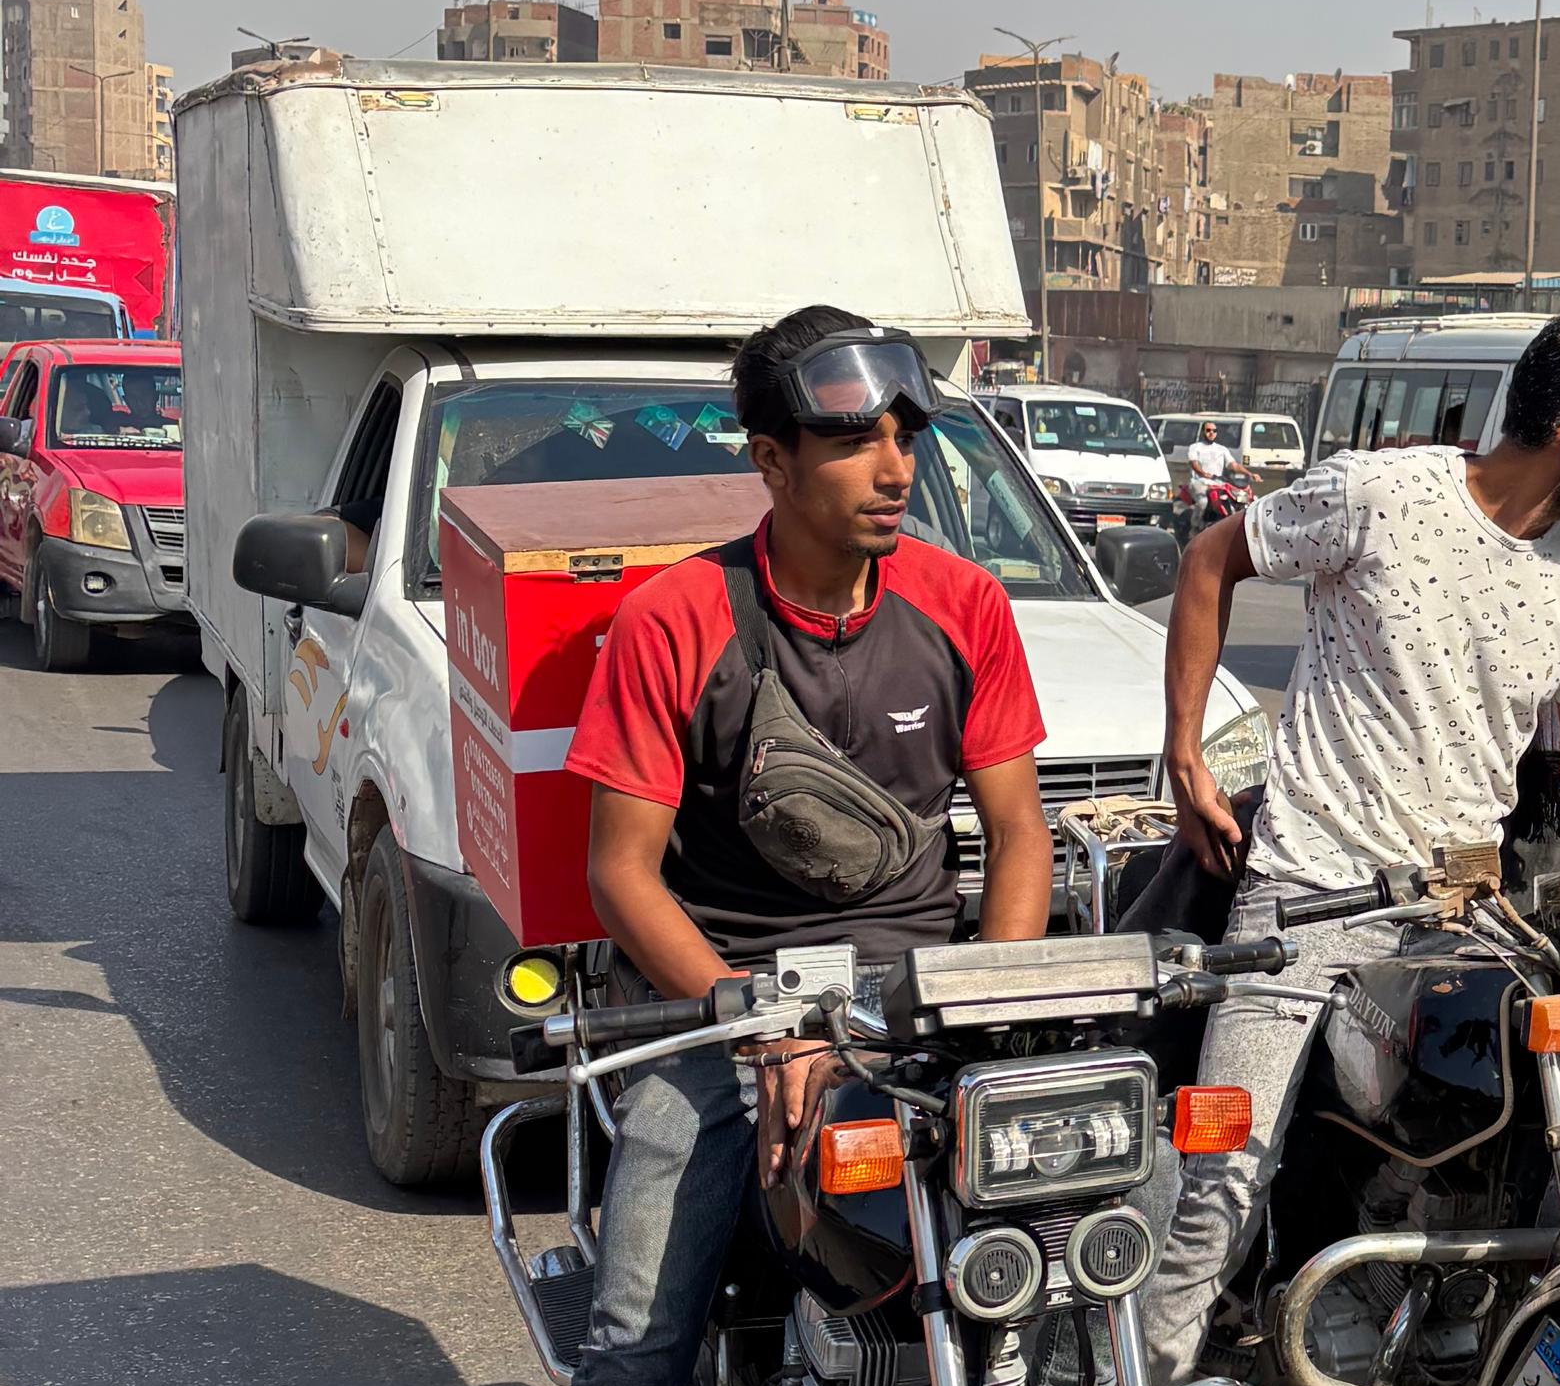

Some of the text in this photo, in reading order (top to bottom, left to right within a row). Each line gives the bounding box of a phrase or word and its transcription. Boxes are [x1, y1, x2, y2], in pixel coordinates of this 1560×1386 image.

[12, 250, 58, 264] نفسك
[12, 267, 53, 281] يوم
[455, 588, 499, 692] in box
[1349, 984, 1397, 1040] DAYUN
